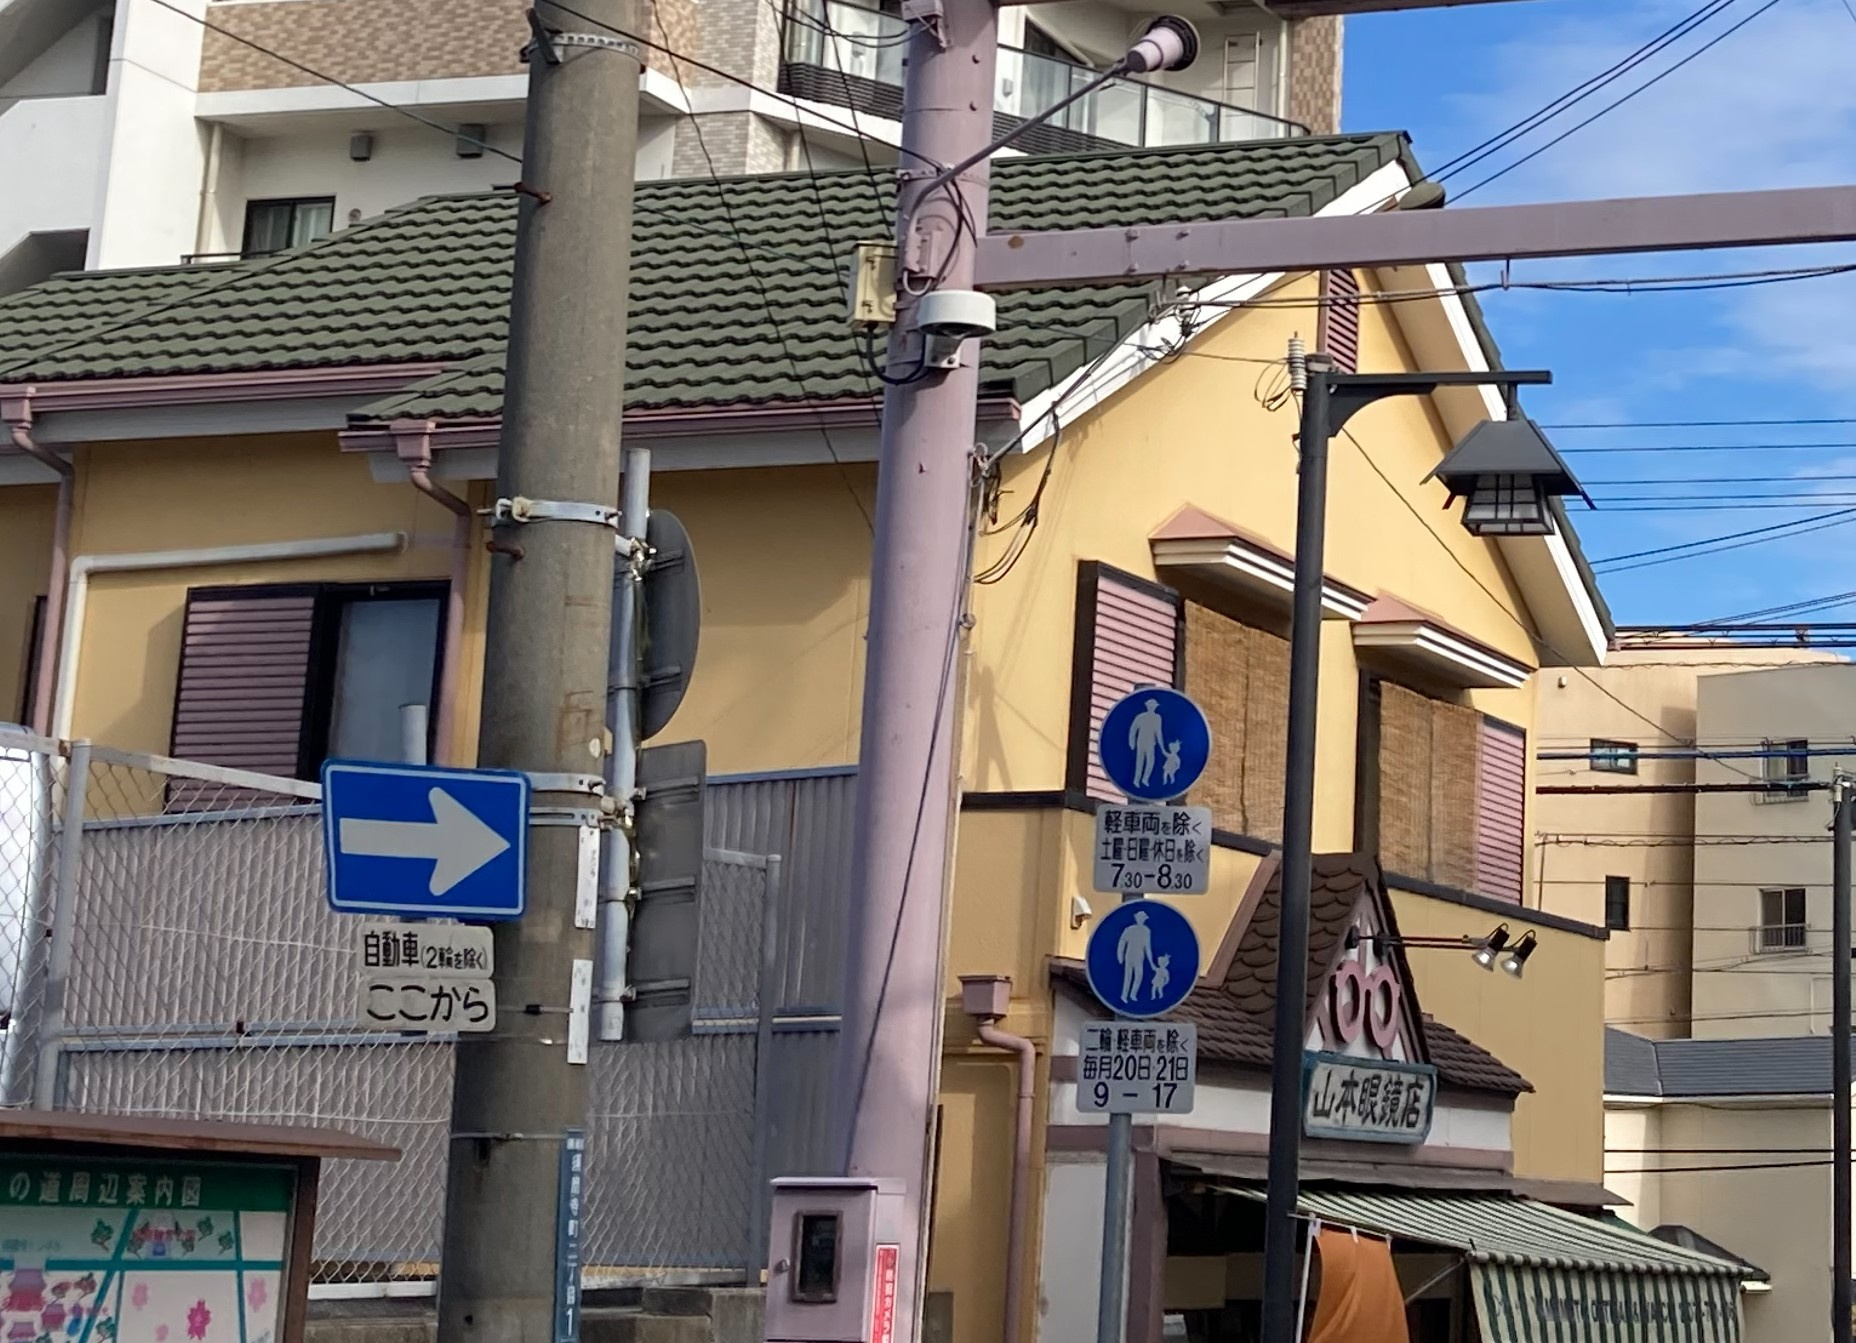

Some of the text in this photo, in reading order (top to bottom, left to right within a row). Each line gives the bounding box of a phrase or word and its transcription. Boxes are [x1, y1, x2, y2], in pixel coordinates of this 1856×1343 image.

[1104, 810, 1201, 836] 軽車両を除く
[366, 984, 489, 1023] ここから
[1093, 1081, 1109, 1108] 9
[1152, 1082, 1178, 1109] 17
[1312, 1068, 1424, 1129] 山本眼鏡店
